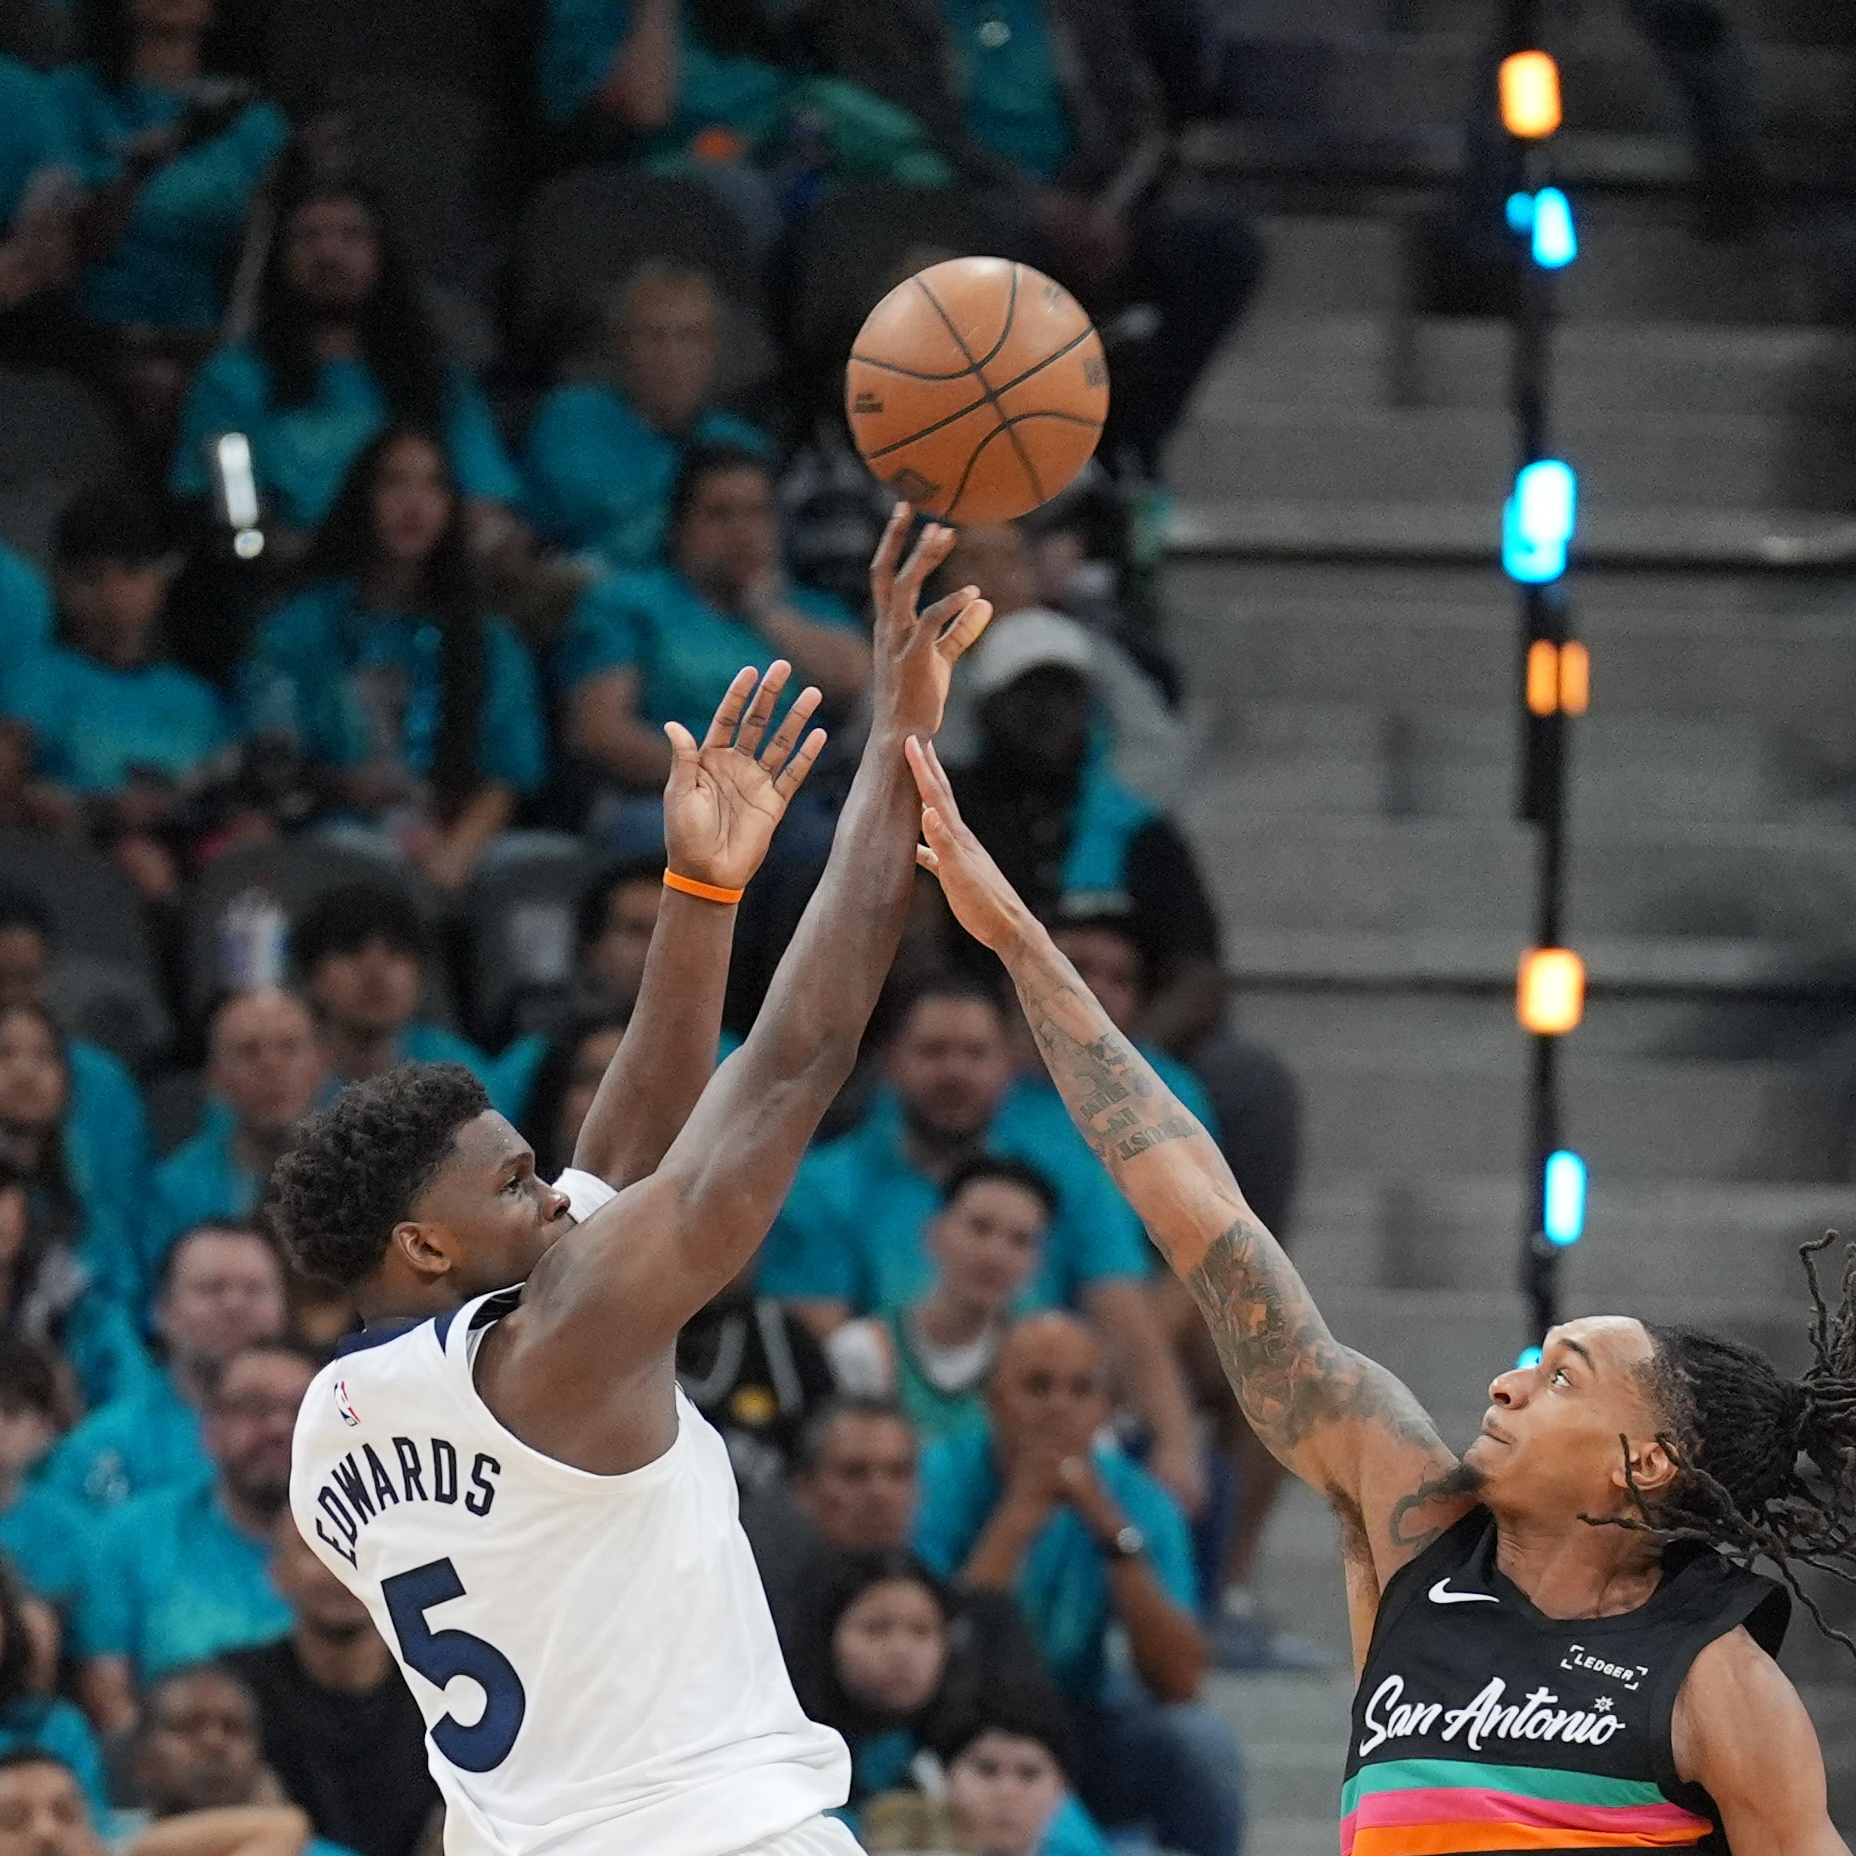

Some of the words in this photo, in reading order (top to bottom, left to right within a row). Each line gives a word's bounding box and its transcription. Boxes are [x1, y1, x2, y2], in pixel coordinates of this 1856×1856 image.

[315, 1436, 501, 1571] EDWARDS
[380, 1556, 527, 1773] 5
[1359, 1674, 1443, 1757] San
[1442, 1676, 1626, 1751] Antonio
[1574, 1652, 1635, 1682] LEDGER
